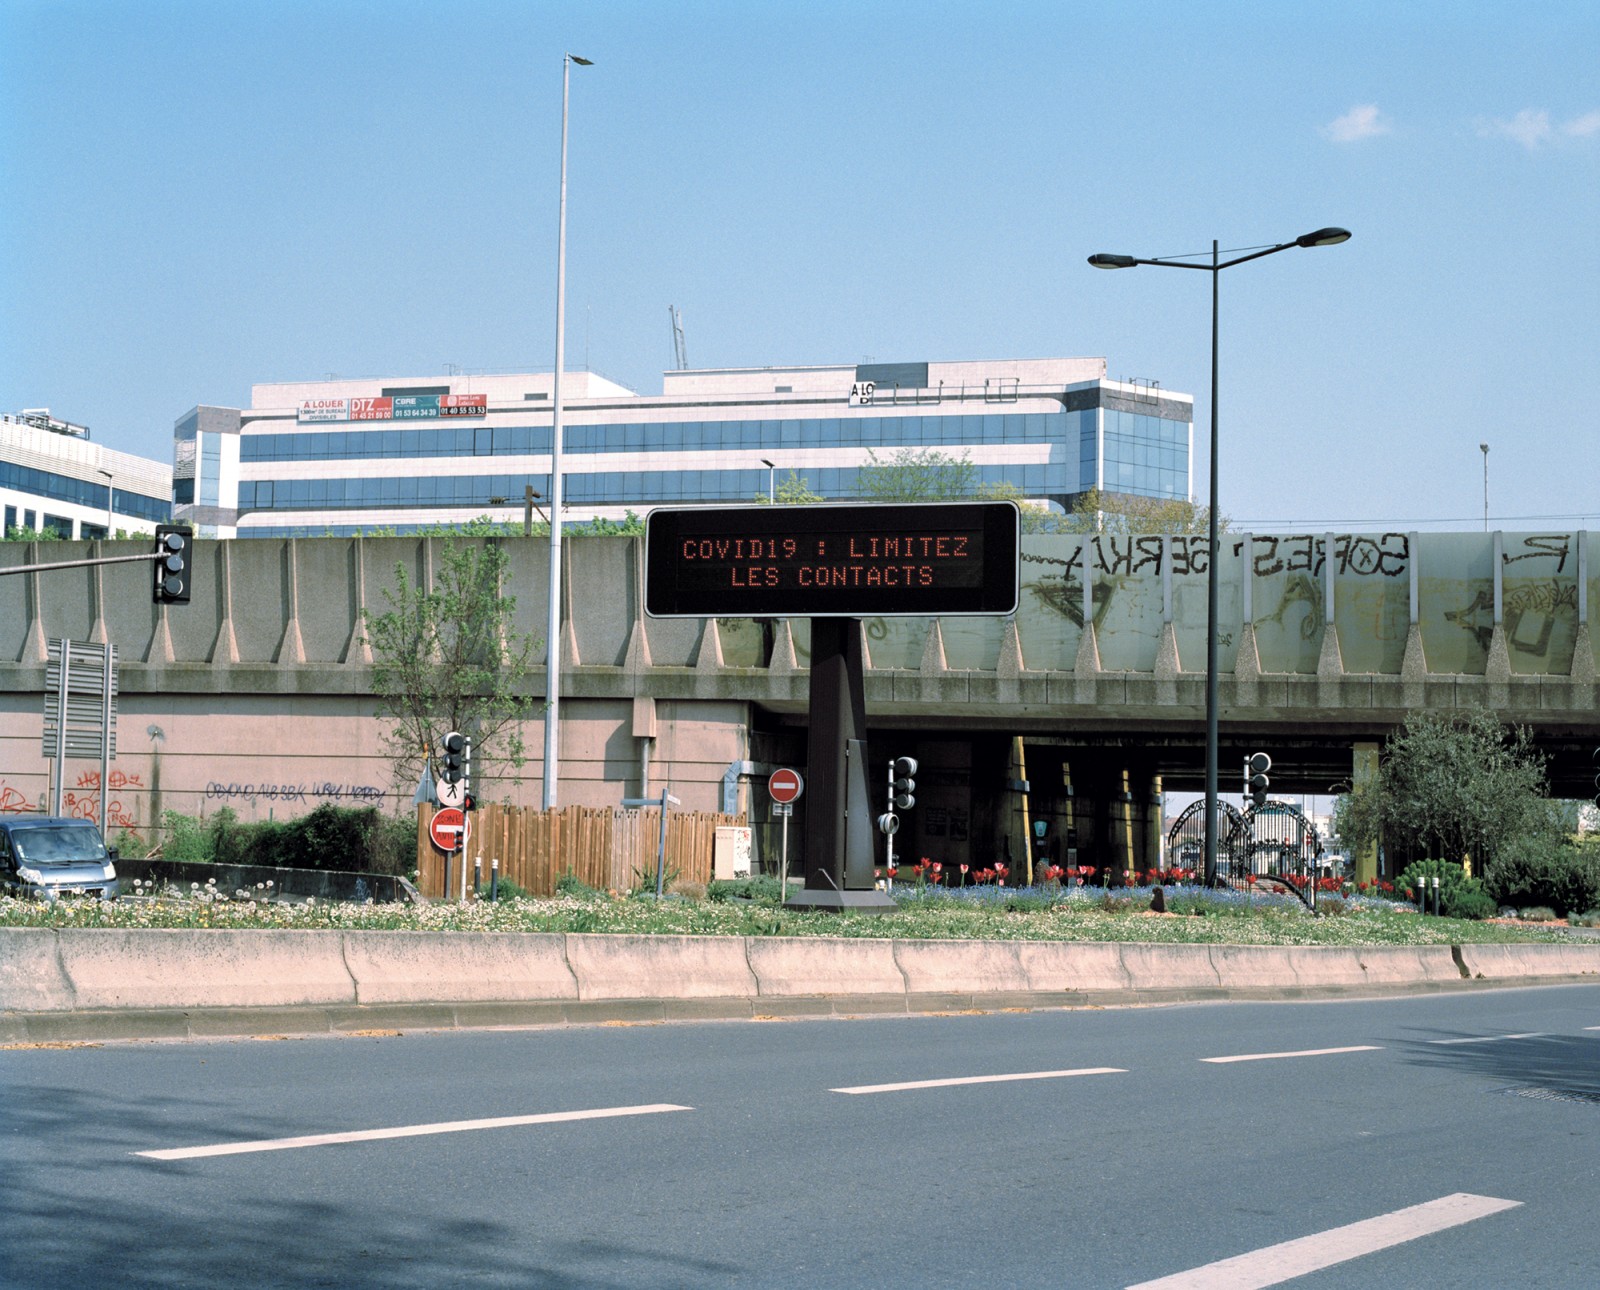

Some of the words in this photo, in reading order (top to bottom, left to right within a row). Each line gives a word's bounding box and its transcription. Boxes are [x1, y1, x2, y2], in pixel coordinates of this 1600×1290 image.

[852, 383, 858, 396] A
[313, 400, 344, 408] LOUER
[352, 399, 375, 411] DTZ
[683, 539, 796, 559] COVID19
[818, 541, 826, 555] :
[849, 537, 968, 557] LIMITEZ
[732, 567, 779, 586] LES
[799, 565, 933, 586] CONTACTS
